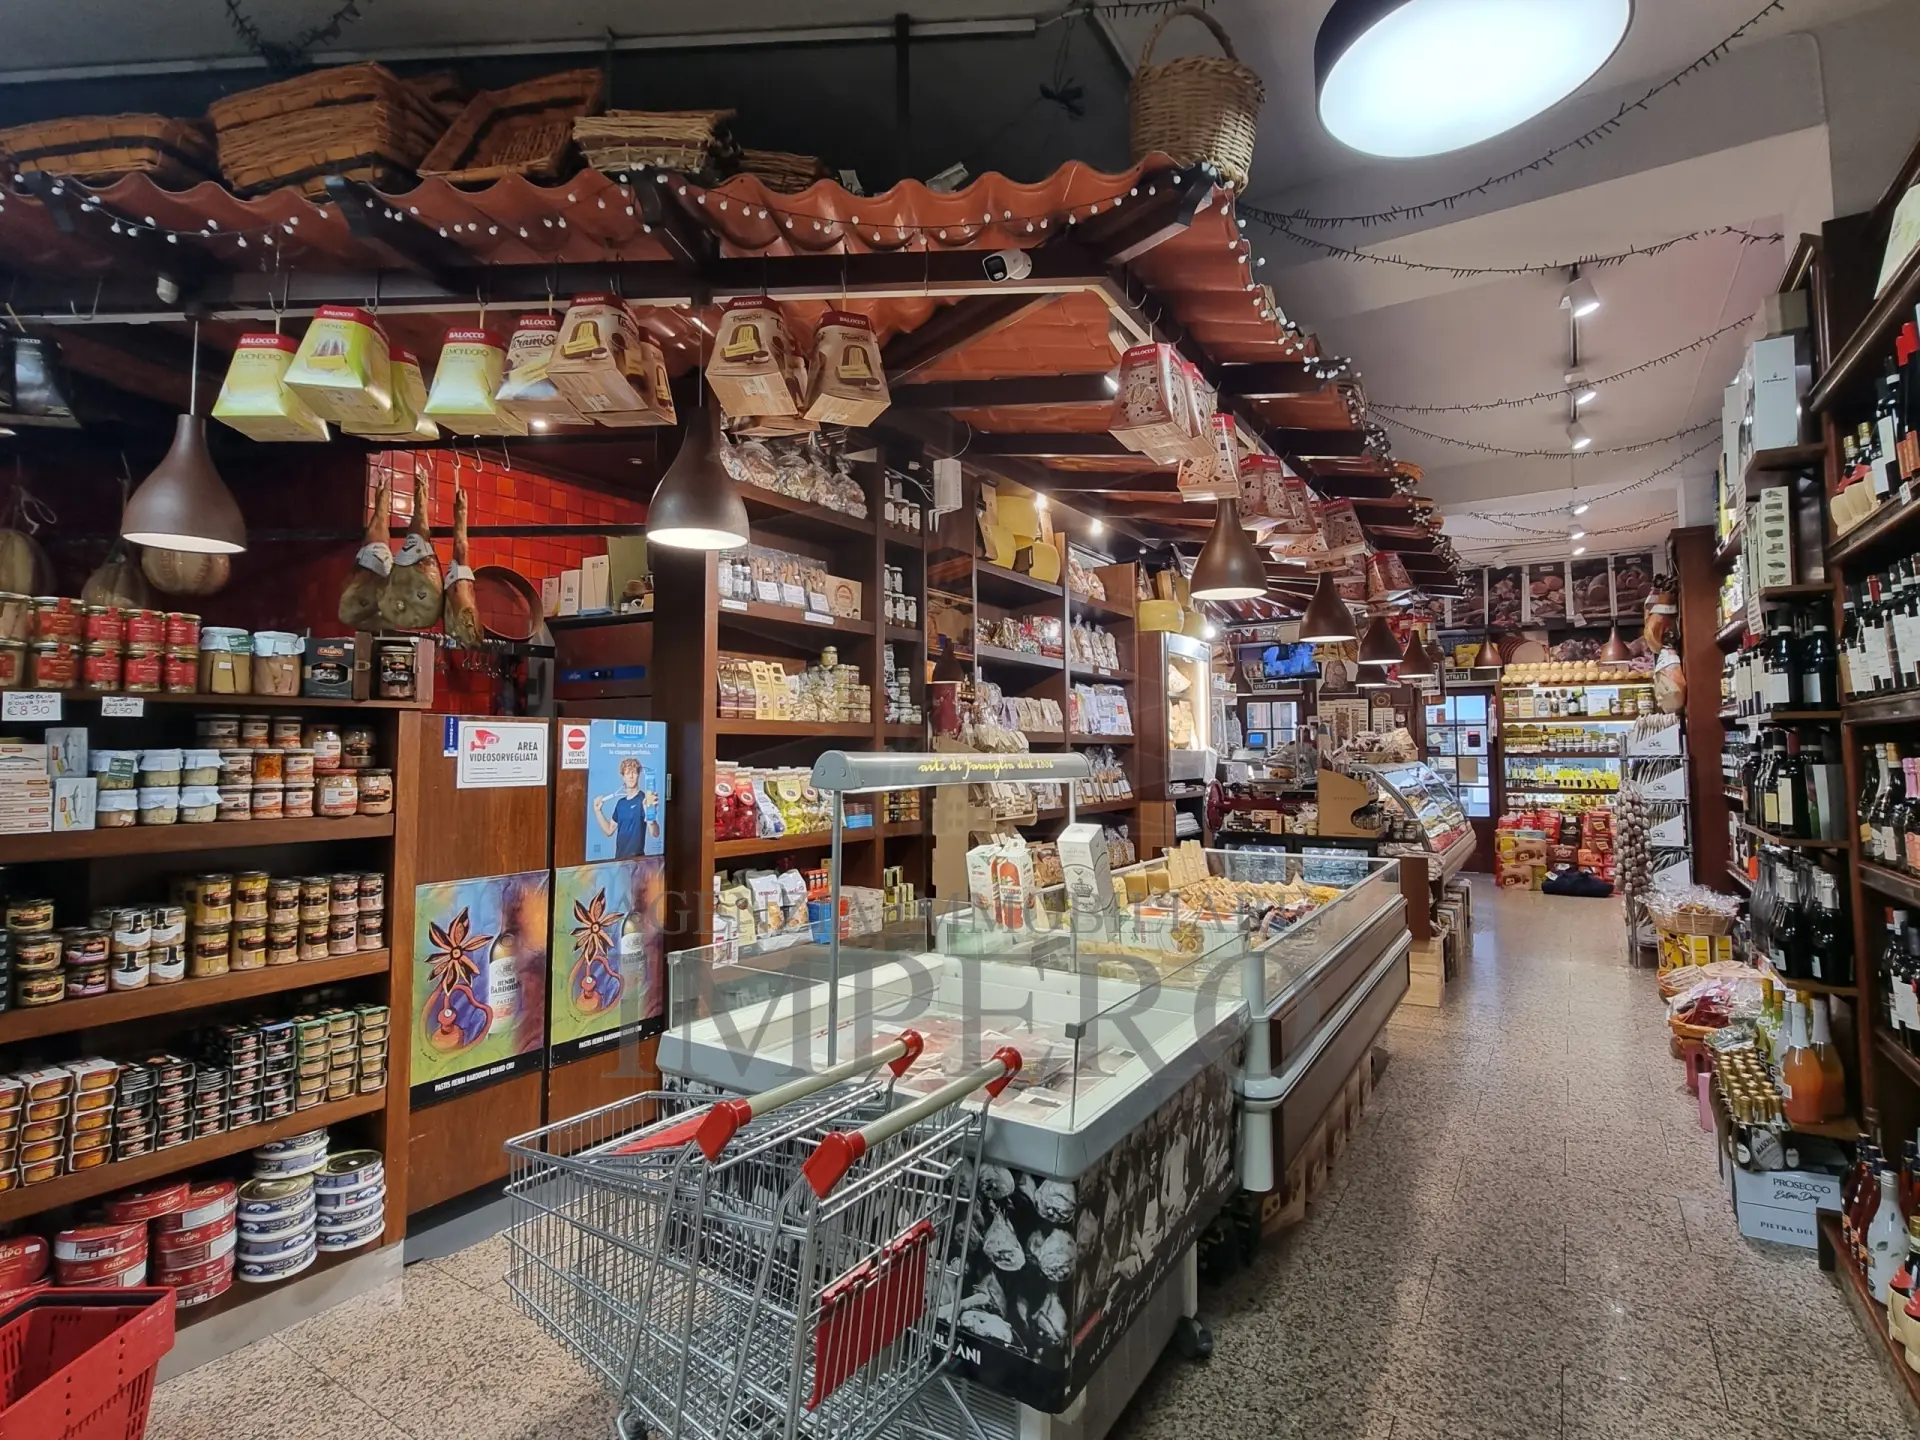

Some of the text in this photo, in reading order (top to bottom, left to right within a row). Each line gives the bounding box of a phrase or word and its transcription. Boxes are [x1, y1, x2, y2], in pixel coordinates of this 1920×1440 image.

[323, 310, 354, 318] BALOCCO
[519, 318, 556, 327] BALOCCO
[449, 331, 485, 339] BALOCCO
[240, 336, 279, 345] BALOCCO
[1130, 347, 1156, 357] BALOCCO
[1253, 682, 1275, 691] USCITA
[517, 741, 538, 751] AREA
[469, 752, 539, 762] VIDEOSORVEGLIATA
[918, 759, 947, 773] arte
[949, 758, 963, 773] di
[962, 755, 1015, 780] famiglia
[1016, 756, 1034, 771] dal
[578, 1039, 592, 1049] PASTIS
[591, 1036, 604, 1046] HENRI
[434, 1061, 516, 1093] PASTIS HENRI BARDOUIN GRAND CRU
[1772, 1177, 1832, 1195] PROSECCO
[1760, 1221, 1815, 1236] PIETRA DEL
[103, 1256, 131, 1270] CALLIPO
